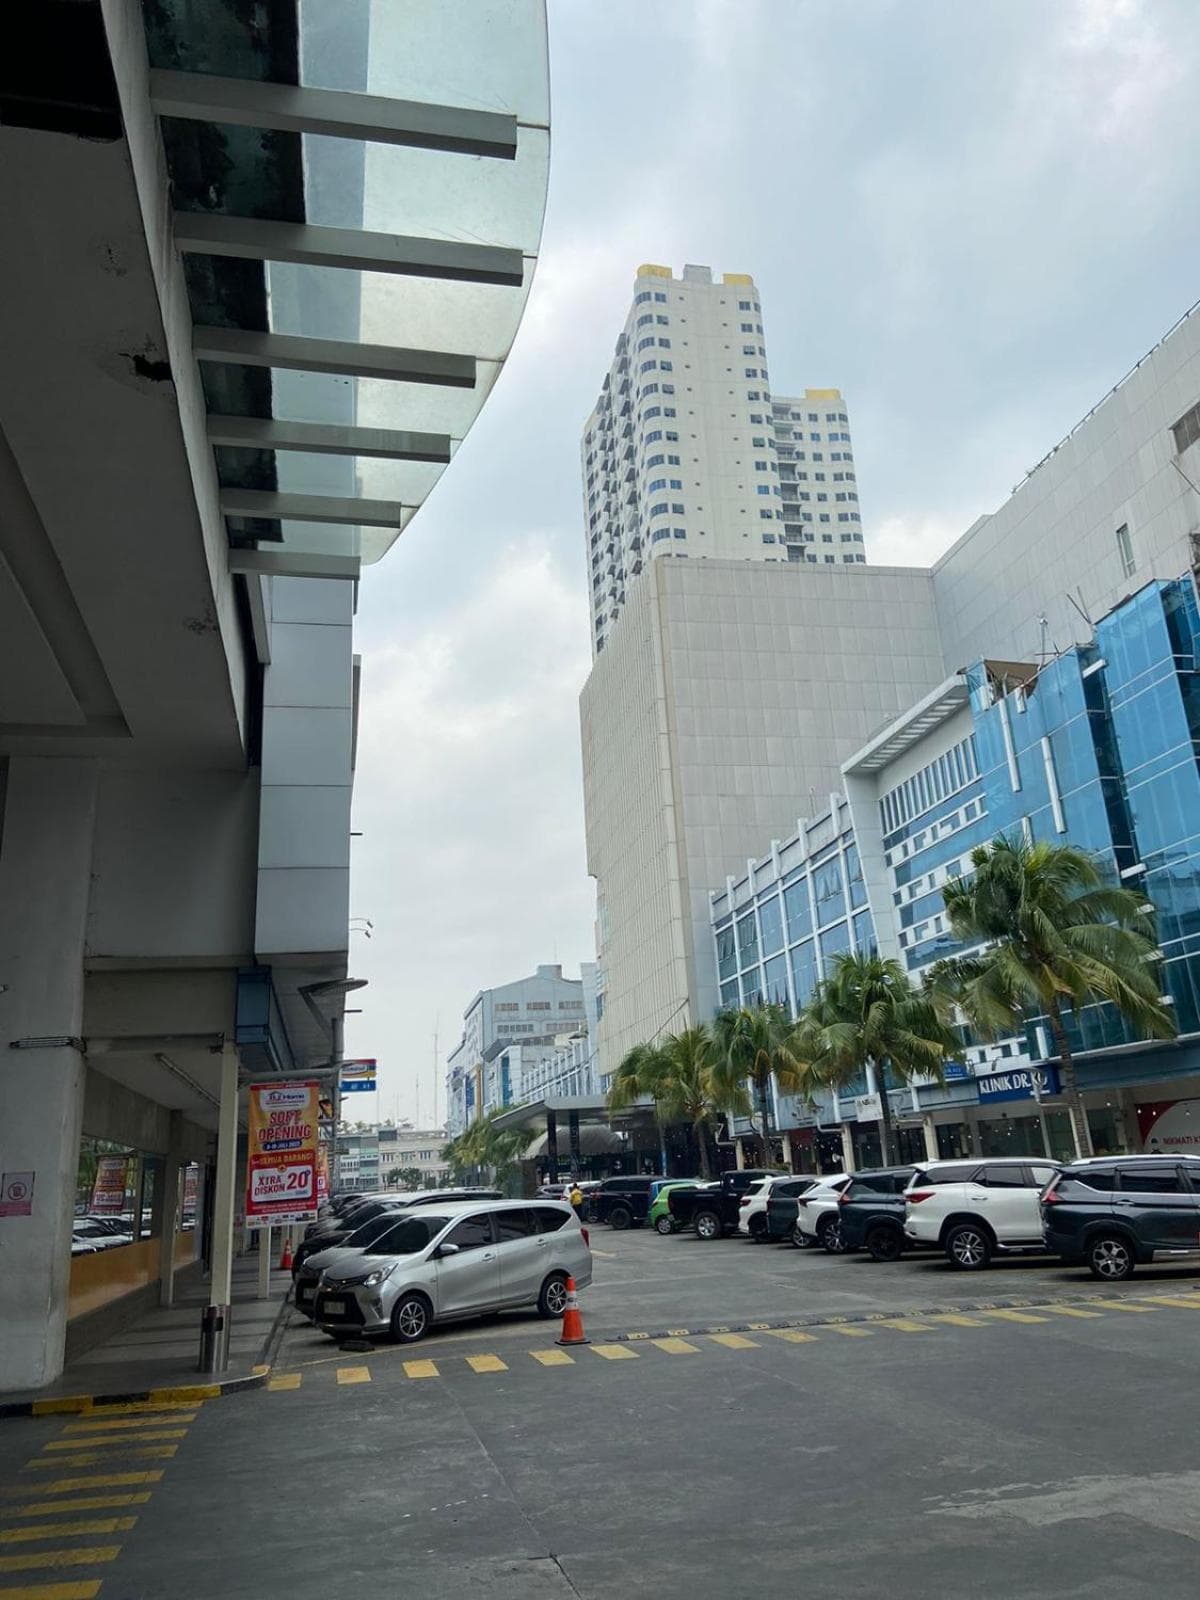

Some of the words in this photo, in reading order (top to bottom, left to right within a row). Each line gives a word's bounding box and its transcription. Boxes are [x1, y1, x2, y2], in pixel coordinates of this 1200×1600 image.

[980, 1075, 1012, 1095] KLINIK
[270, 1110, 302, 1125] SOFT
[258, 1124, 312, 1141] OPENING
[258, 1175, 281, 1187] XTRA
[254, 1185, 285, 1196] DISKON
